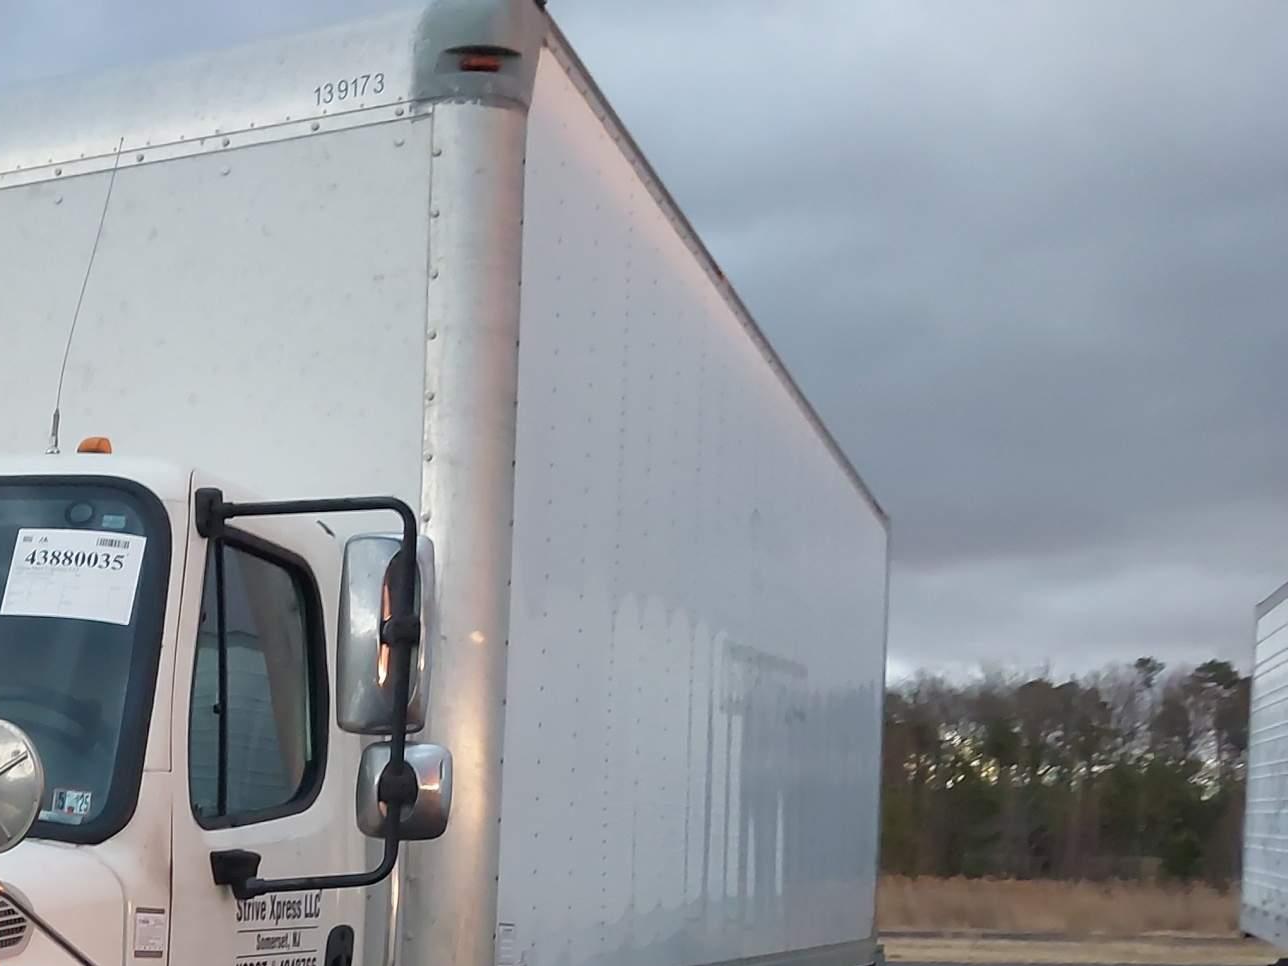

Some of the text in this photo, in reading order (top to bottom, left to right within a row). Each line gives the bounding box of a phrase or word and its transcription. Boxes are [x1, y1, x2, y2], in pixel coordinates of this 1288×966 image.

[314, 72, 385, 106] 139173
[24, 549, 126, 572] 43880035
[236, 892, 321, 926] Strive Xpress LLC
